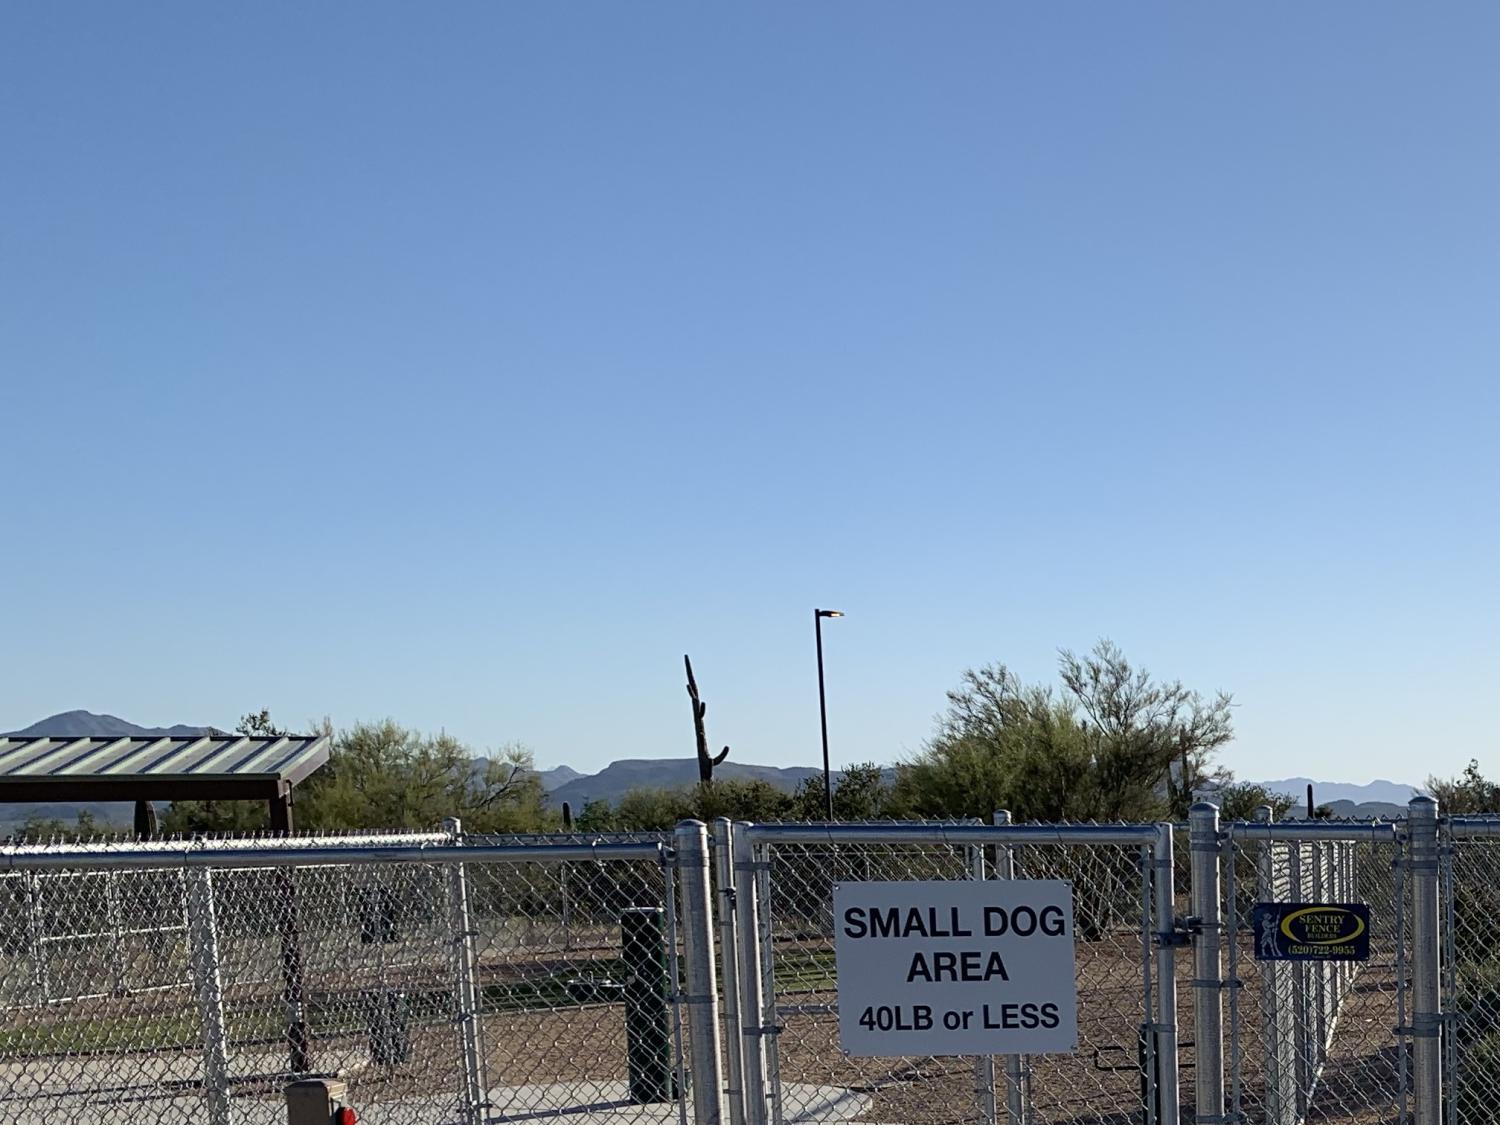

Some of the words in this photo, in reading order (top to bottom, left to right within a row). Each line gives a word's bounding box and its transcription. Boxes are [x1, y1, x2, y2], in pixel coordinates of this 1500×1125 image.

[843, 906, 972, 939] SMALL
[983, 905, 1066, 938] DOG
[1299, 914, 1345, 924] SENTRY
[1304, 924, 1341, 933] FENCE
[906, 951, 1010, 983] AREA
[859, 1005, 934, 1032] 40LB
[942, 1010, 974, 1031] or
[982, 1003, 1060, 1030] LESS
